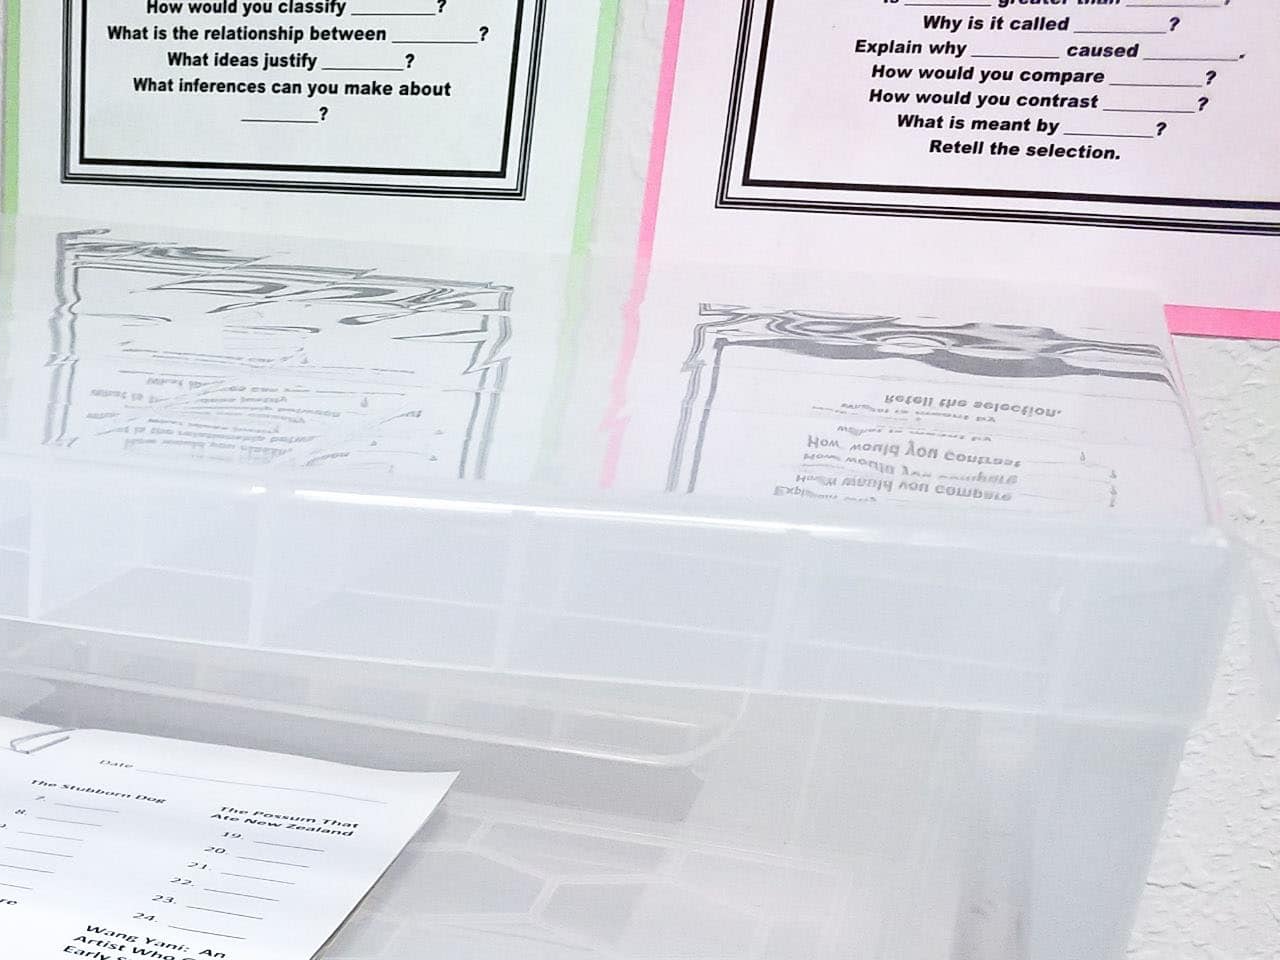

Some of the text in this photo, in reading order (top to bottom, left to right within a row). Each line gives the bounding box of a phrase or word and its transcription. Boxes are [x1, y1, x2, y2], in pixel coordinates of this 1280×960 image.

[146, 0, 346, 17] How would you classify
[107, 26, 386, 43] What is the relationship between
[922, 15, 1069, 34] Why is it called
[855, 40, 1139, 59] Explain why caused
[167, 52, 318, 71] What ideas justify
[871, 64, 1105, 88] How would you compare
[132, 77, 451, 99] What inferences can you make about
[869, 89, 1099, 110] How would you contrast
[896, 114, 1059, 136] What is meant by
[929, 140, 1121, 160] Retell the selection.
[98, 759, 134, 769] Date
[31, 779, 167, 805] The Stubborn Dog
[211, 813, 355, 837] Ate New Zealand
[219, 806, 360, 830] The Possum That
[73, 935, 127, 952] Artist
[132, 946, 176, 960] Who
[86, 924, 227, 959] Wang Yani: An
